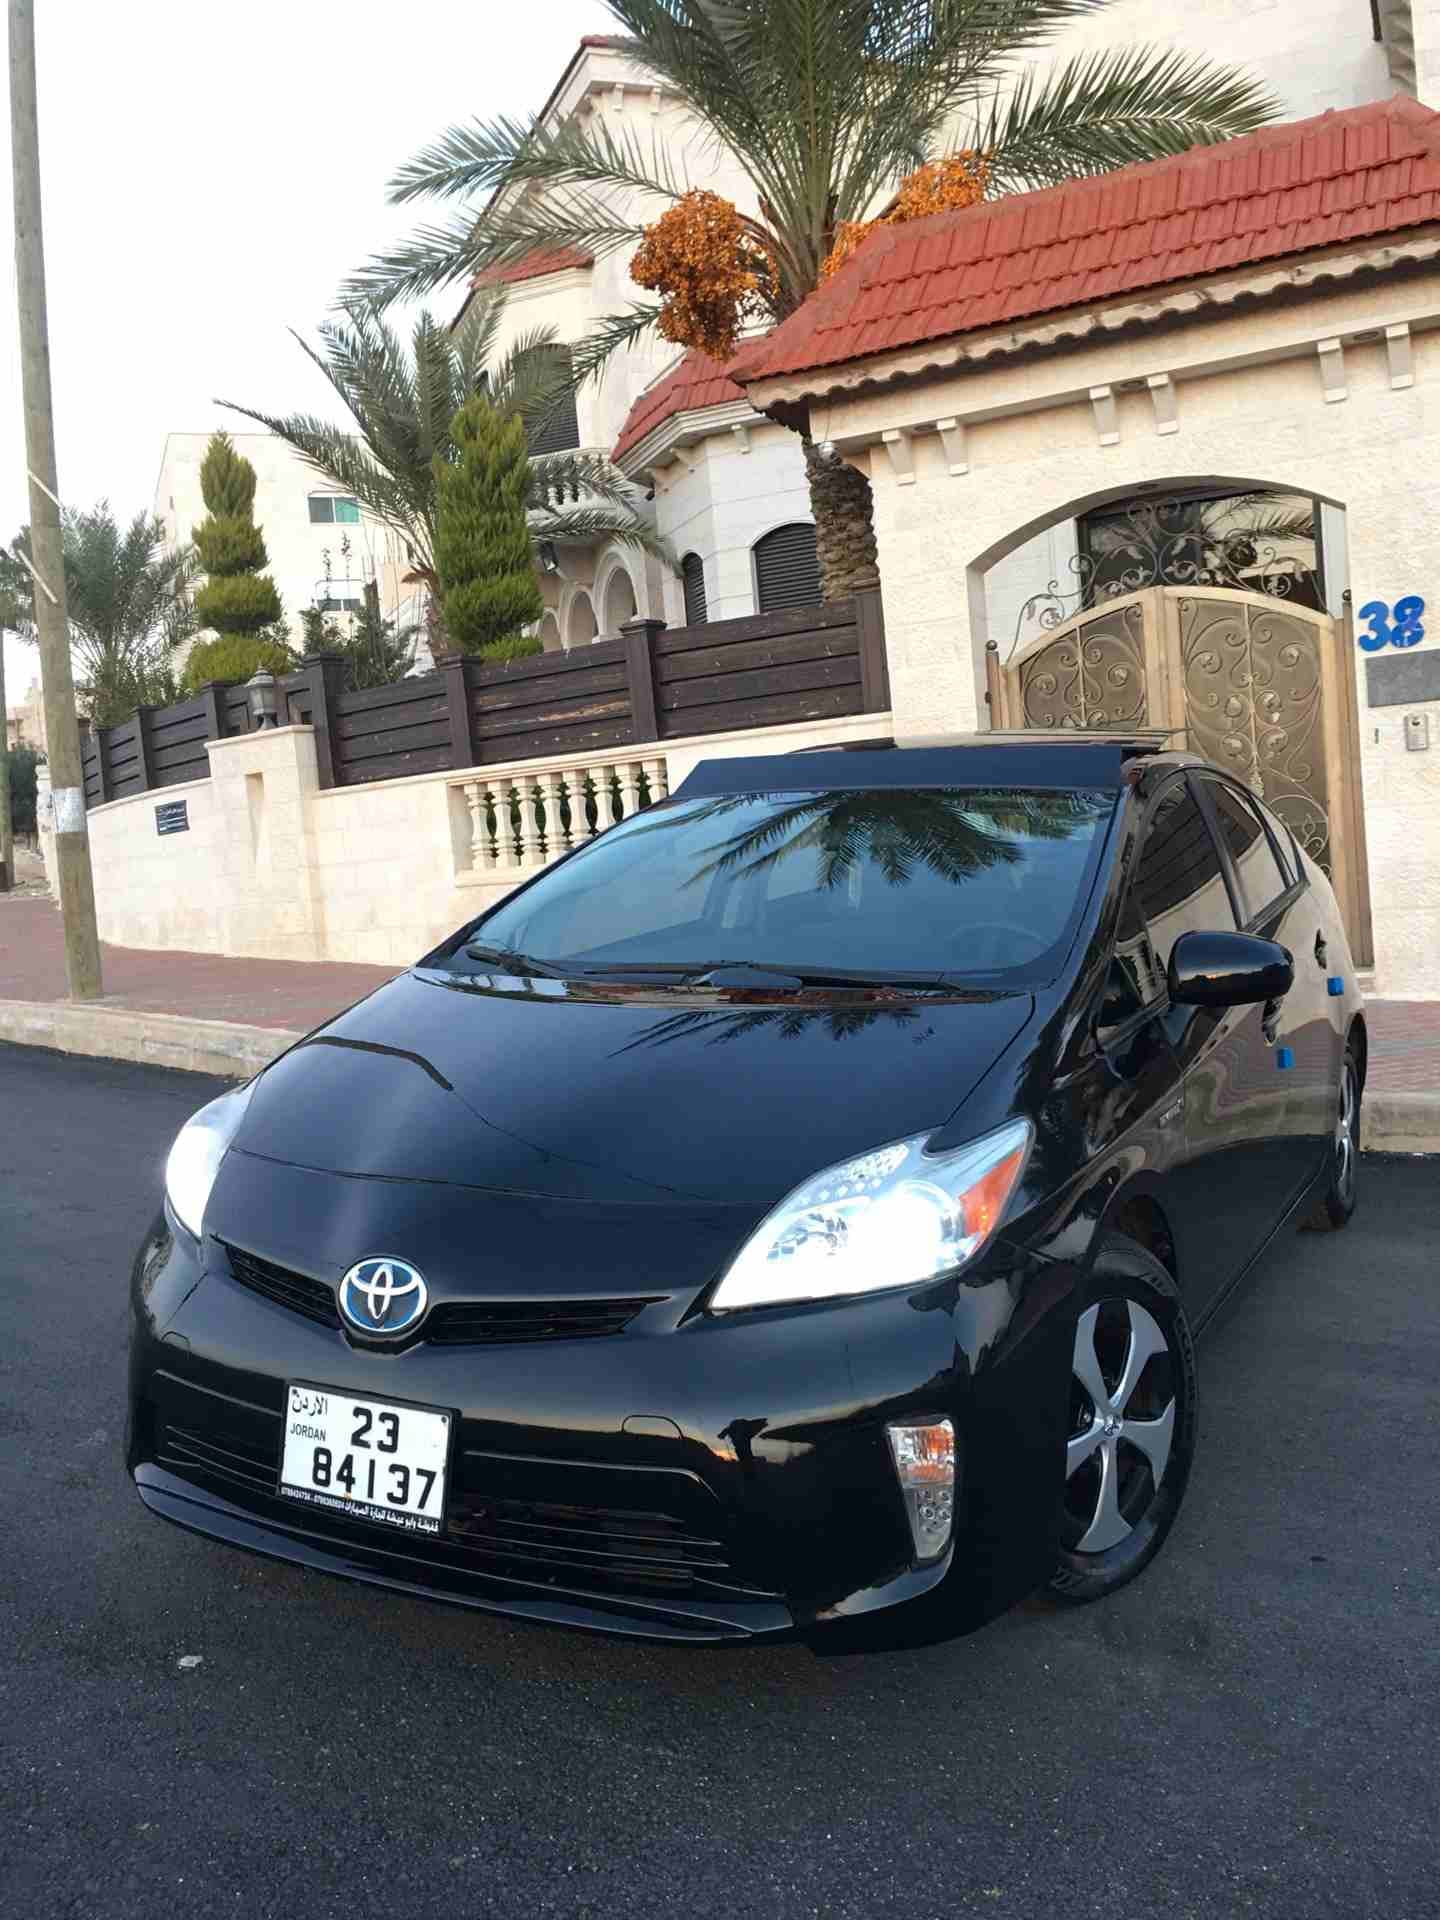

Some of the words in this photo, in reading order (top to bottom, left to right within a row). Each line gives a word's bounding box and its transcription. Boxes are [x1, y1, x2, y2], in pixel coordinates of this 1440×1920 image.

[1358, 595, 1425, 652] 38
[290, 1423, 326, 1441] JORDAN
[352, 1406, 399, 1453] 23
[312, 1446, 437, 1510] 84137
